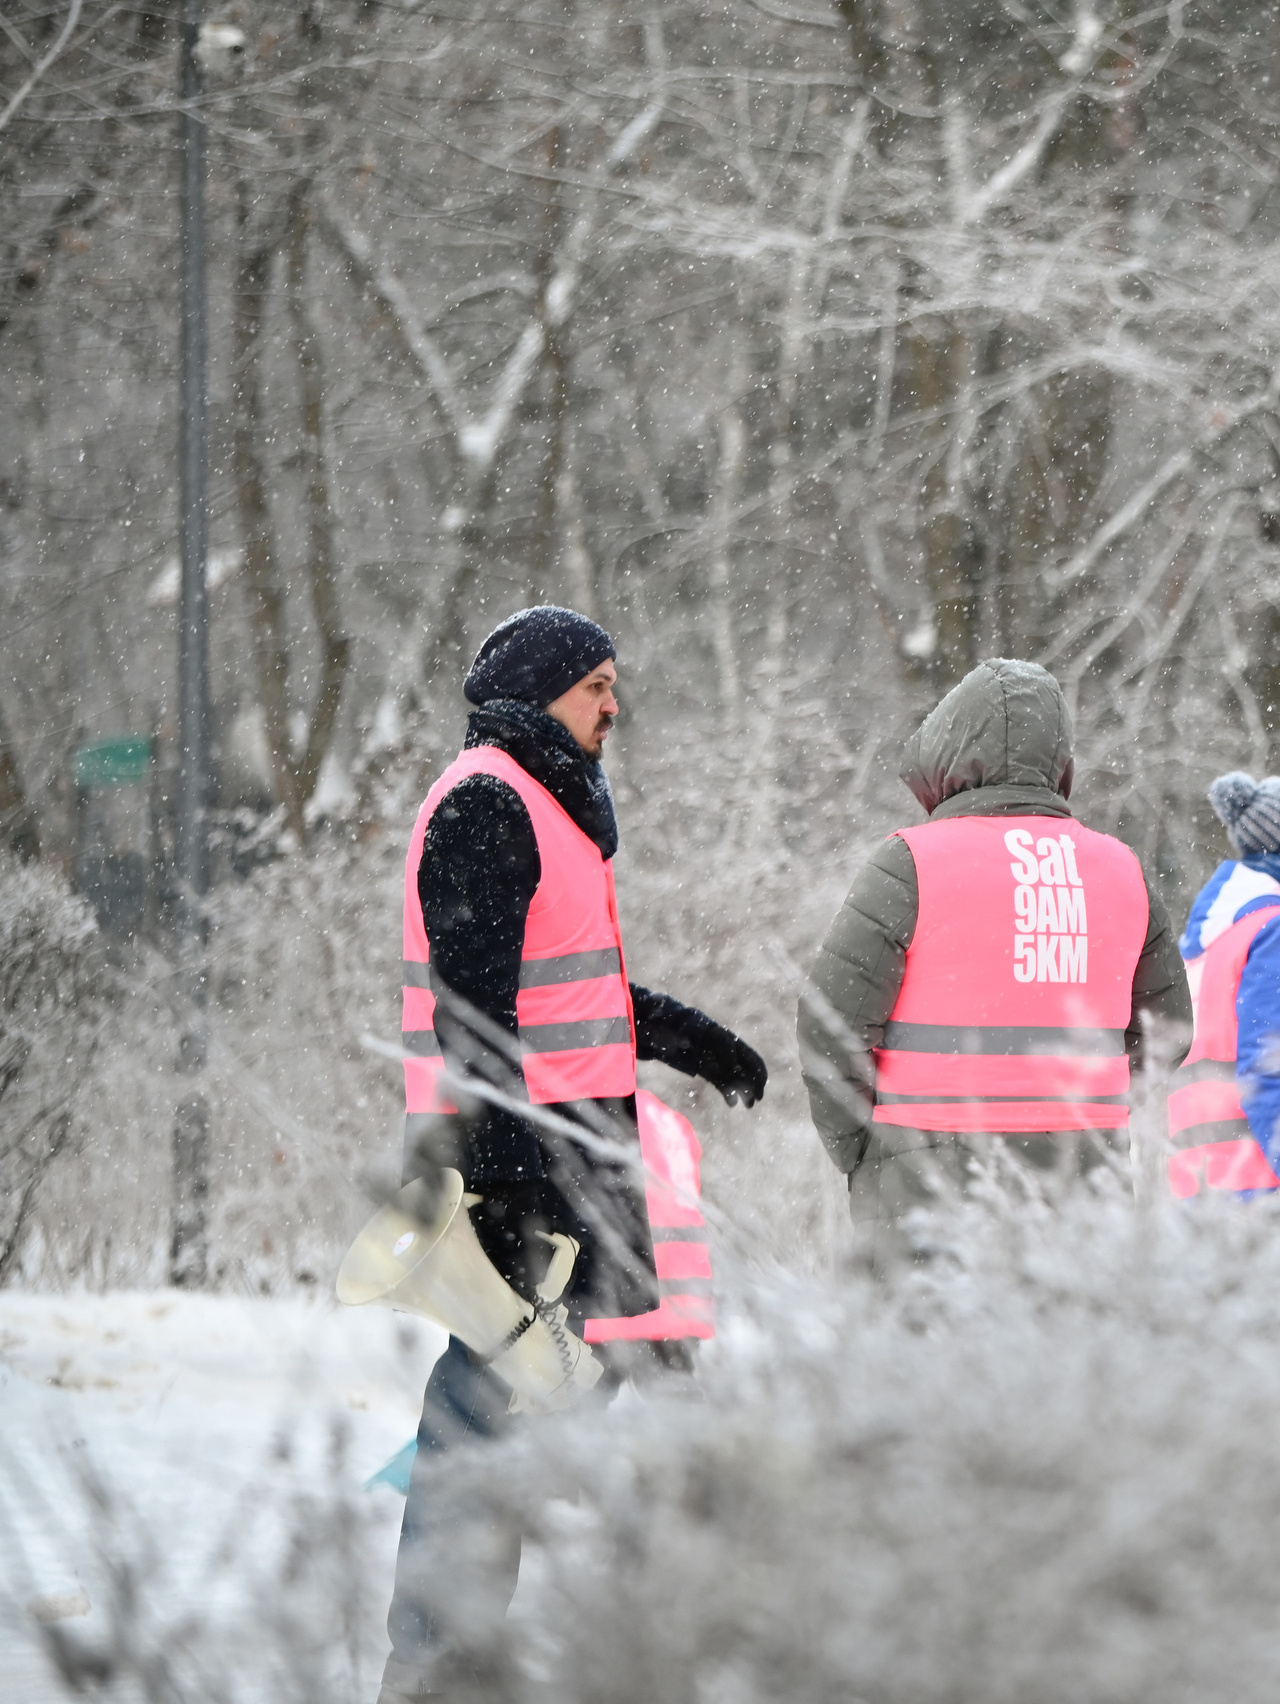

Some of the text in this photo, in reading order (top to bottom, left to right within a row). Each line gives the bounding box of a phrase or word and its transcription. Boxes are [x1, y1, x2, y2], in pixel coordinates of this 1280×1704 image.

[1004, 829, 1083, 886] Sat
[1014, 884, 1088, 934] 9AM
[1013, 934, 1088, 984] 5KM
